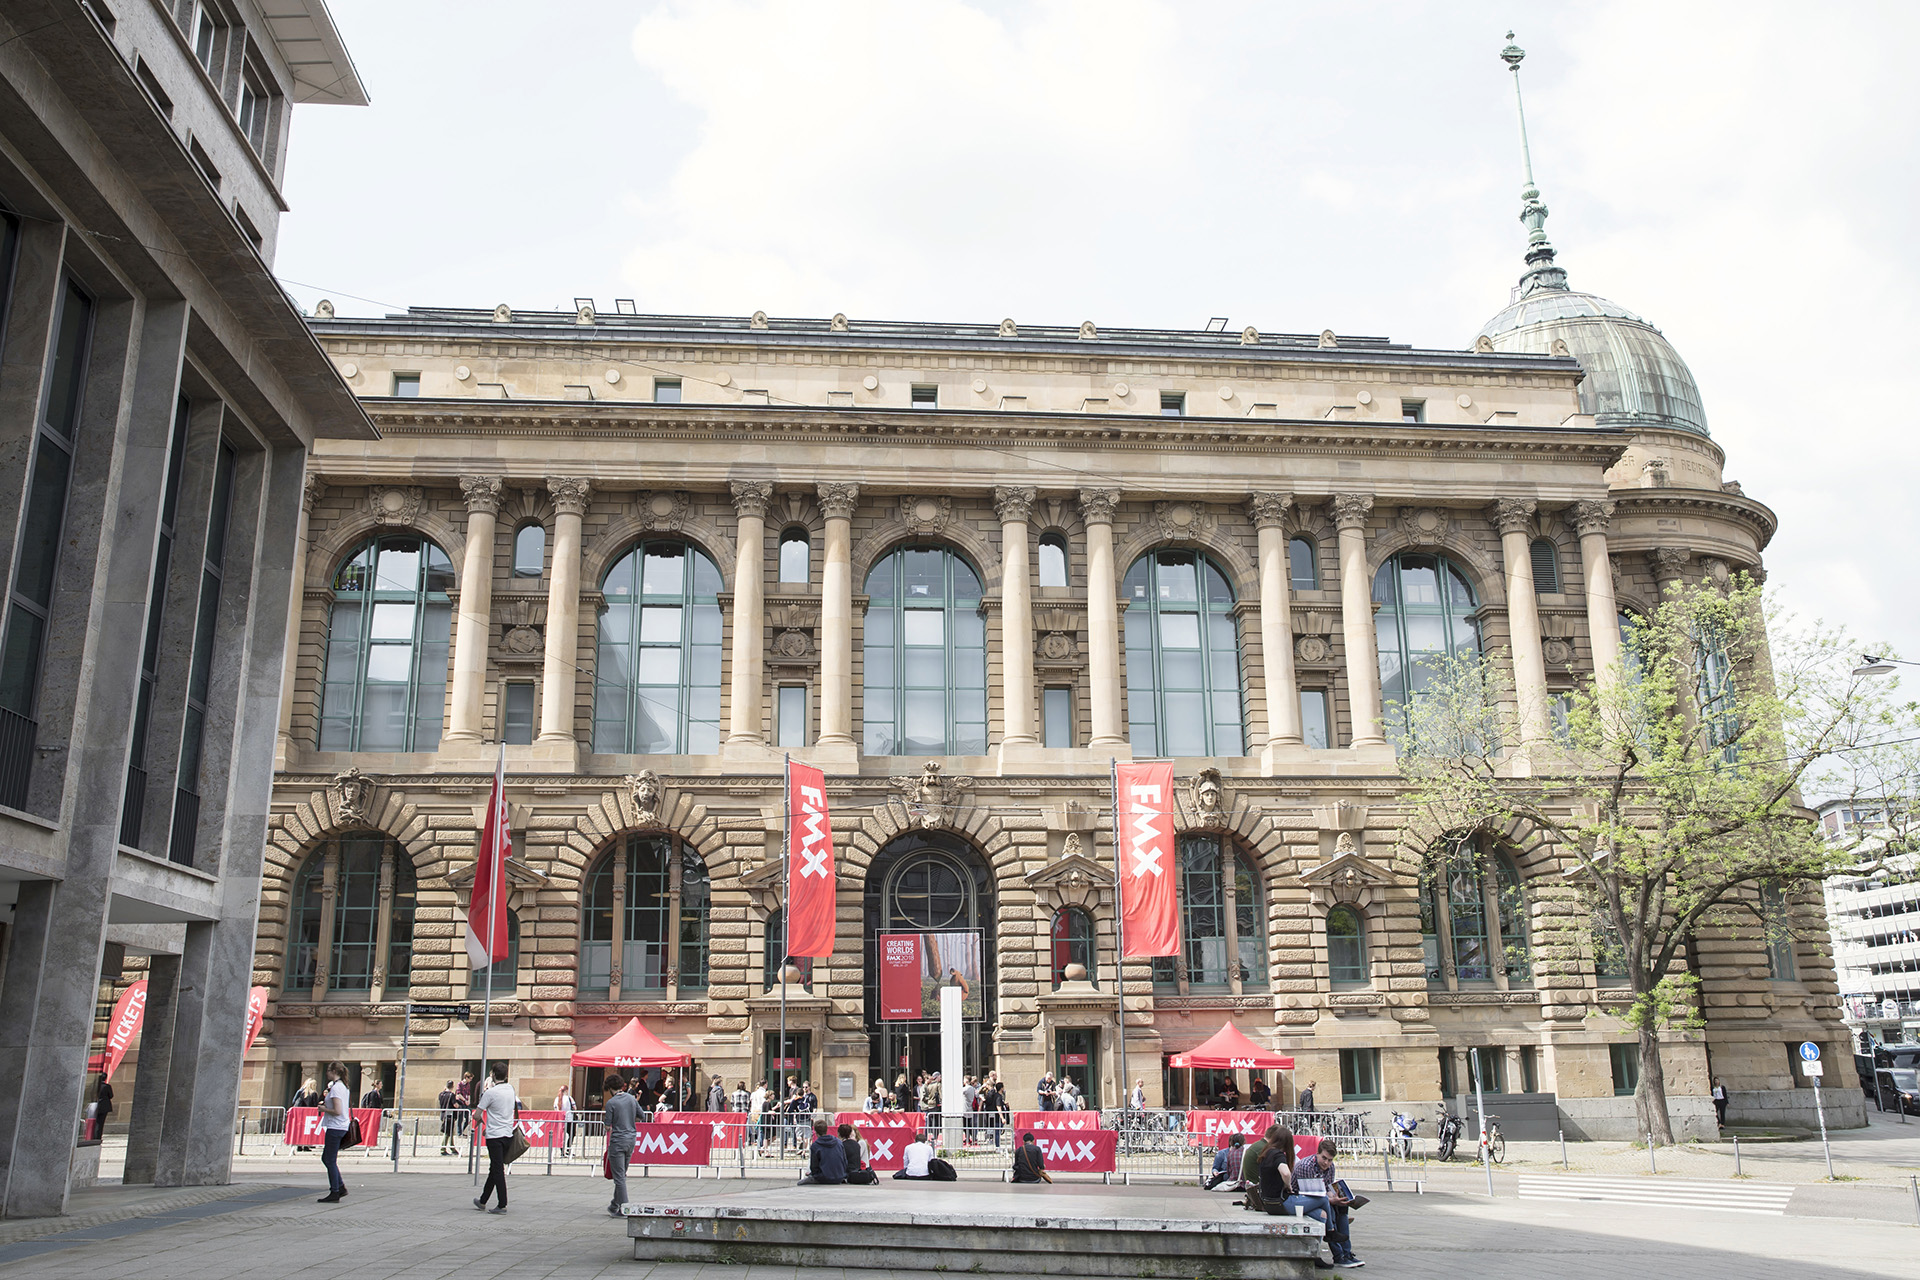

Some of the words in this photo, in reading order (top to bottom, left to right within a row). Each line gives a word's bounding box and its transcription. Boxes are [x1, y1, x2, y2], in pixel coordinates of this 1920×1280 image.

[800, 785, 829, 879] FMX
[1130, 784, 1163, 879] FMX
[886, 946, 914, 954] WORLDS
[109, 988, 147, 1051] TICKETS
[614, 1056, 642, 1067] FMX
[1230, 1058, 1256, 1068] FMX
[1205, 1118, 1256, 1137] FMX
[1036, 1139, 1096, 1162] FMX
